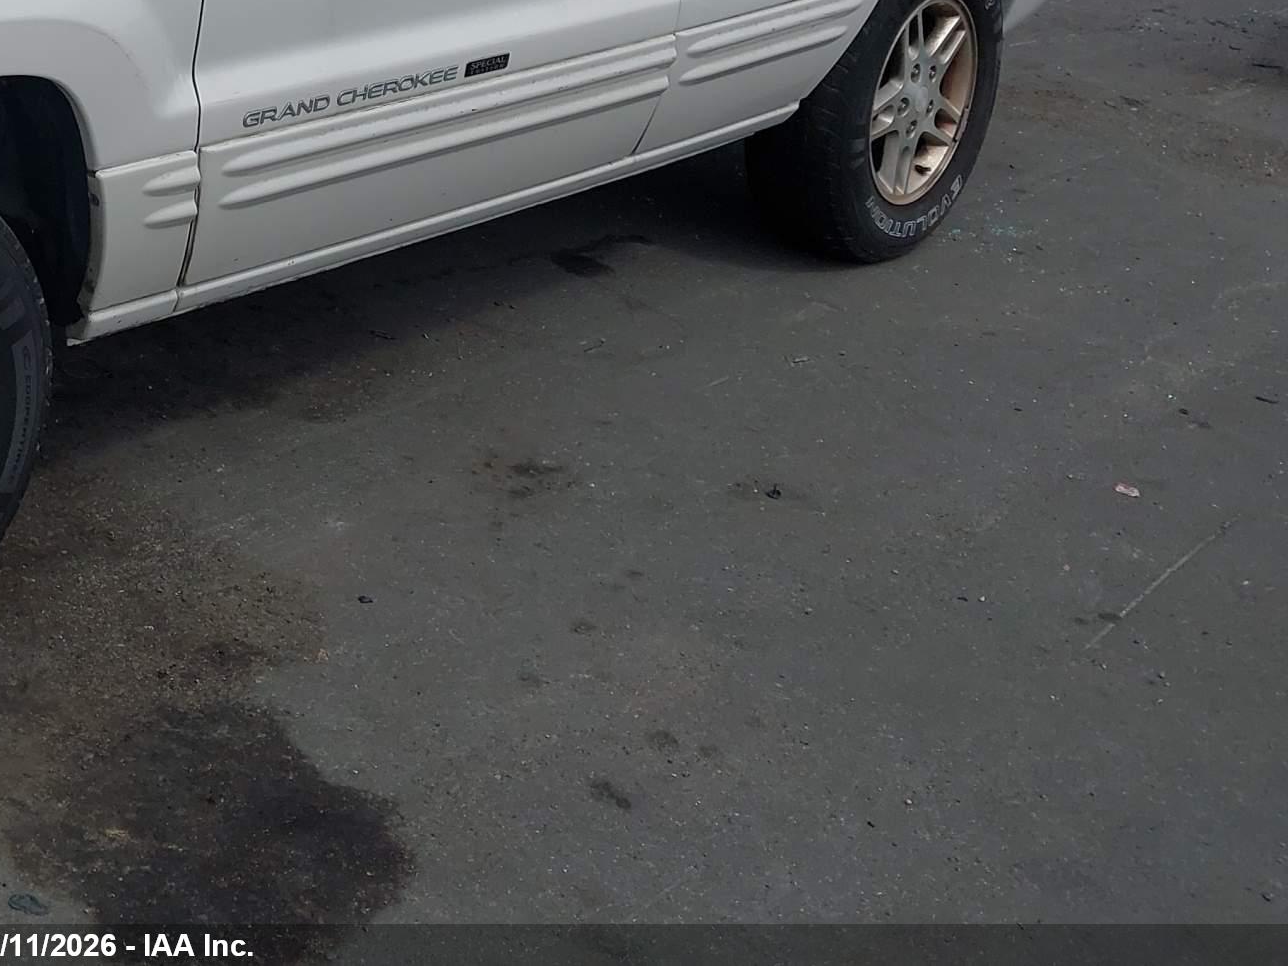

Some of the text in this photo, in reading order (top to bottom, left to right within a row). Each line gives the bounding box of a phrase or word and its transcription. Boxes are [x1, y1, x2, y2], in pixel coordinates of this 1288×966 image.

[470, 56, 506, 70] SPECIAL
[242, 65, 460, 129] GRAND CHEROKEE
[864, 174, 965, 240] EVOLUTION
